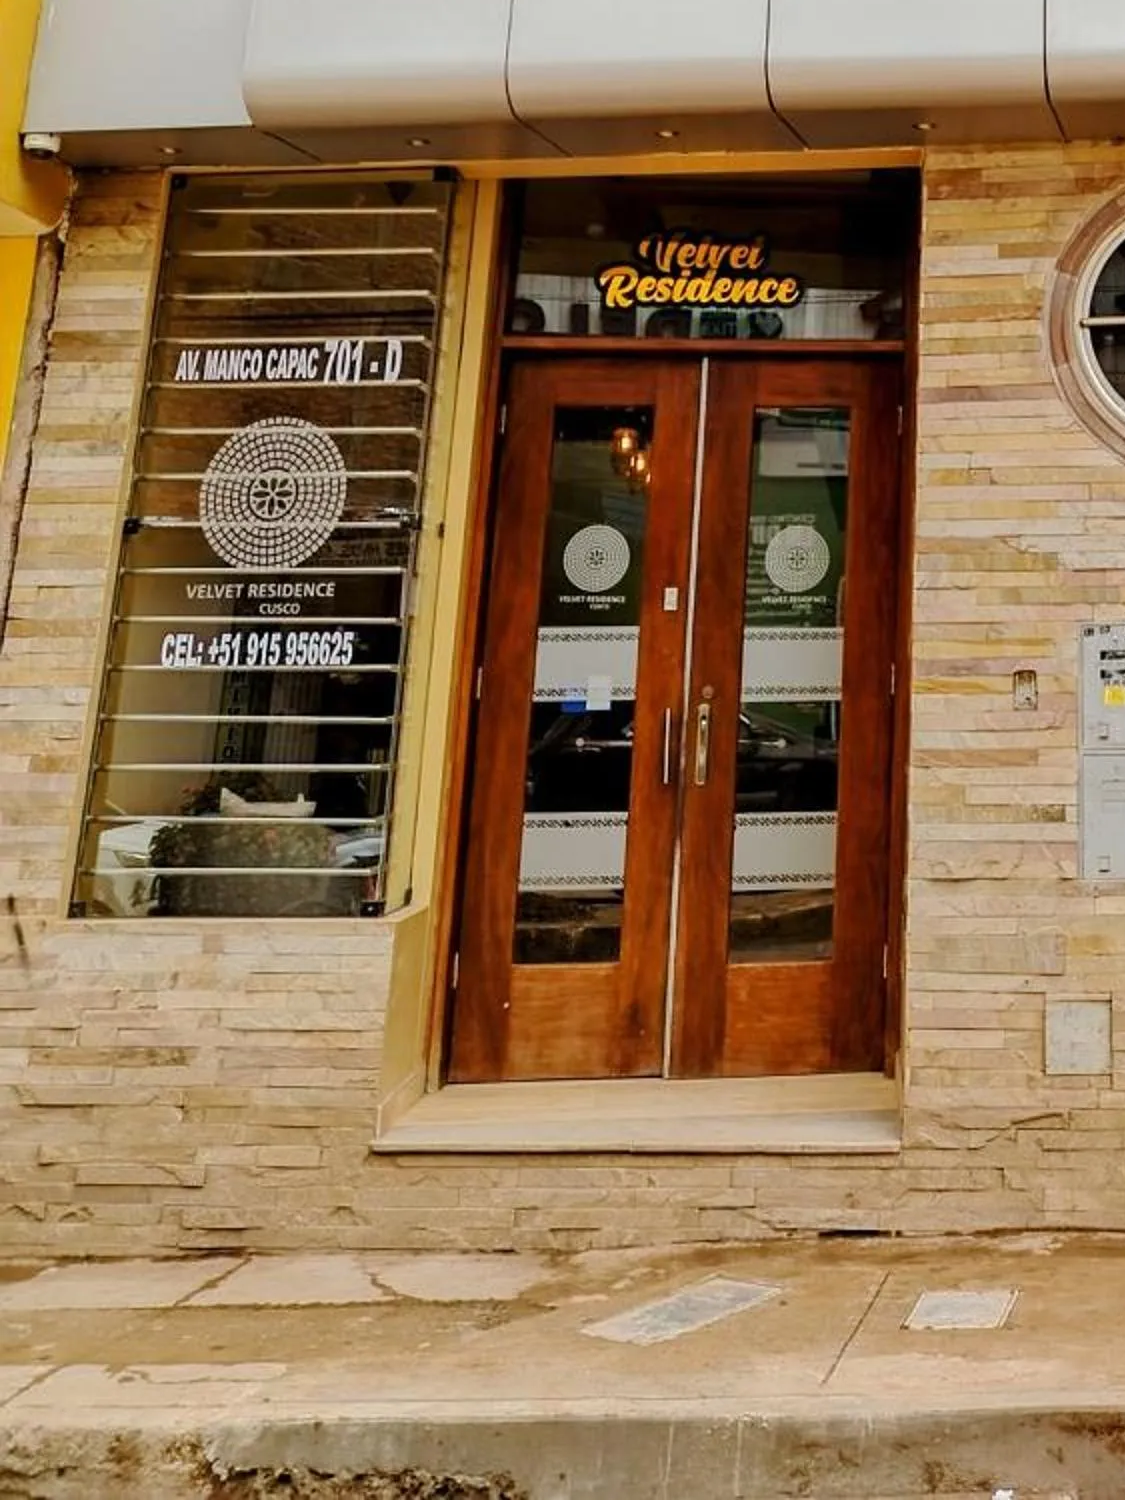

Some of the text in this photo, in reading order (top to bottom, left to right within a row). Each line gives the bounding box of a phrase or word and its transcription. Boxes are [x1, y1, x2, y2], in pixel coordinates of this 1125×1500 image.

[638, 235, 767, 273] Velvet
[599, 265, 799, 308] Residence
[174, 350, 200, 381] AV.
[203, 349, 263, 381] MANCO
[265, 347, 320, 380] CAPAC
[322, 339, 365, 384] 701
[383, 339, 404, 383] D
[186, 582, 336, 599] VELVET RESIDENCE
[258, 603, 301, 615] CUSCO
[161, 631, 355, 668] CEL: +51 915 956625
